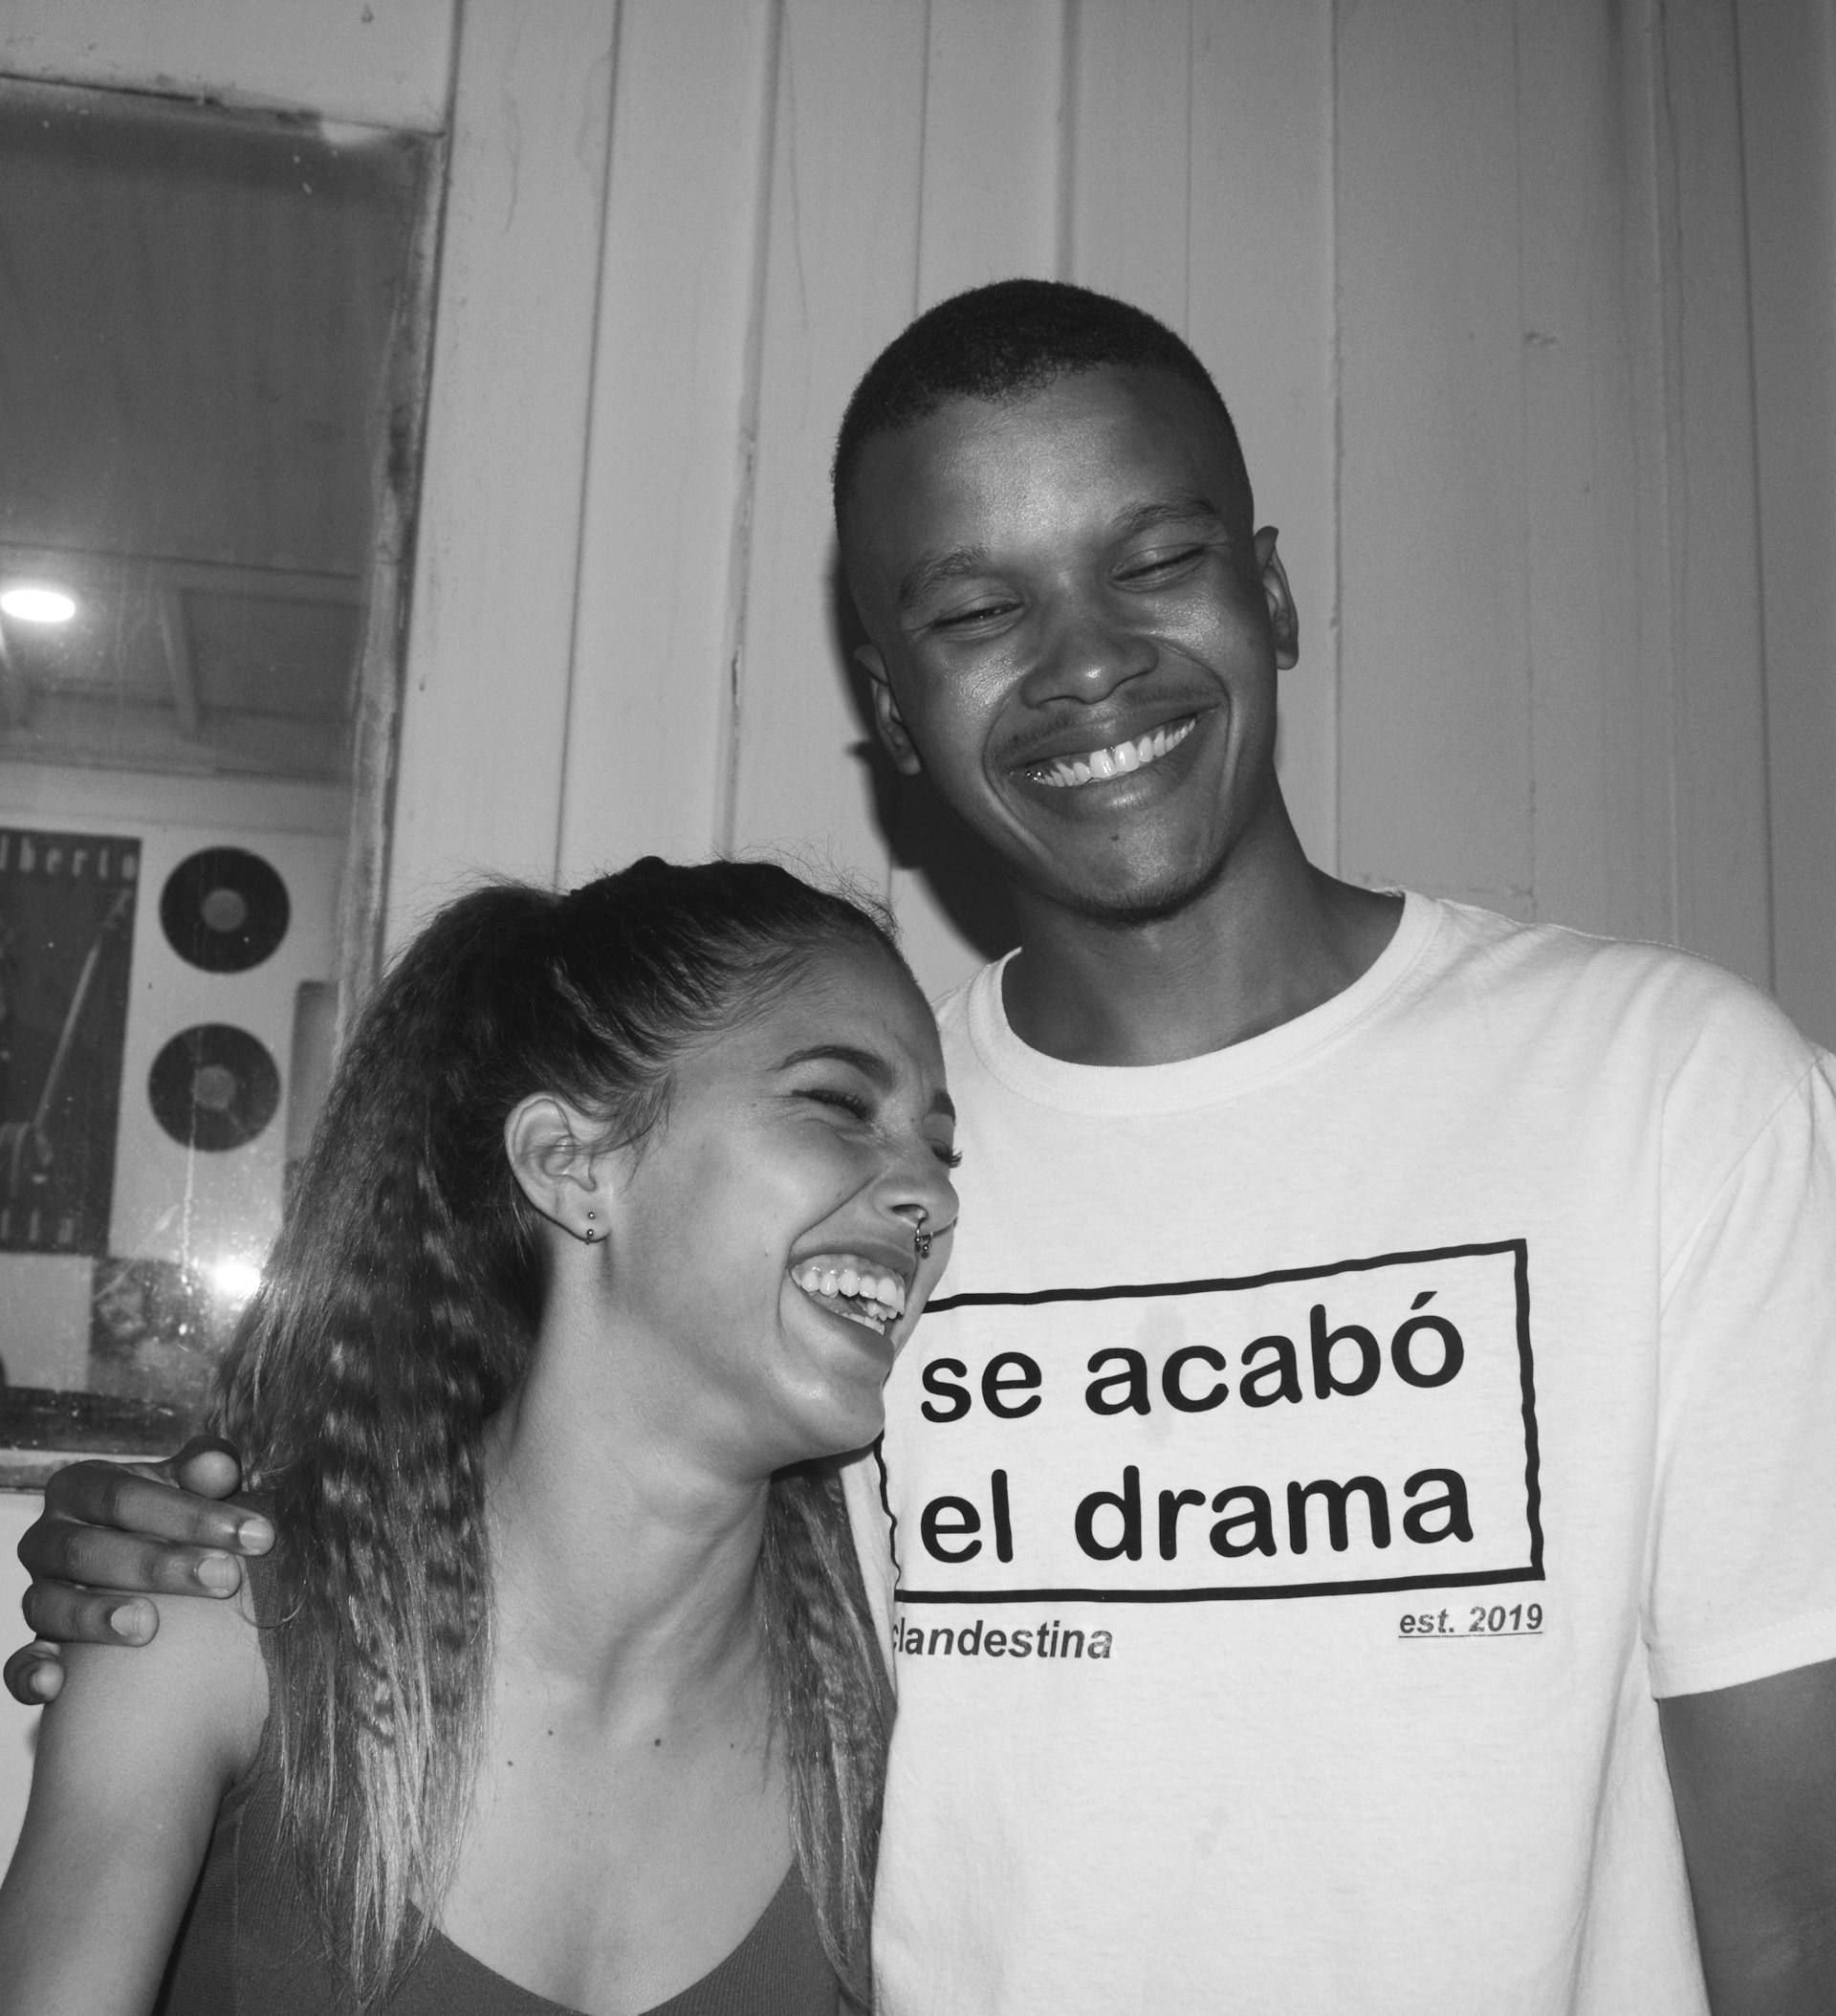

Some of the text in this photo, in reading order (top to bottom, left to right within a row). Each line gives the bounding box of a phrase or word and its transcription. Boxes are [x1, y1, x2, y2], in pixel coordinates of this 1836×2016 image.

[920, 1290, 1465, 1424] se acabó
[920, 1464, 1475, 1564] el drama
[1399, 1603, 1543, 1633] est. 2019
